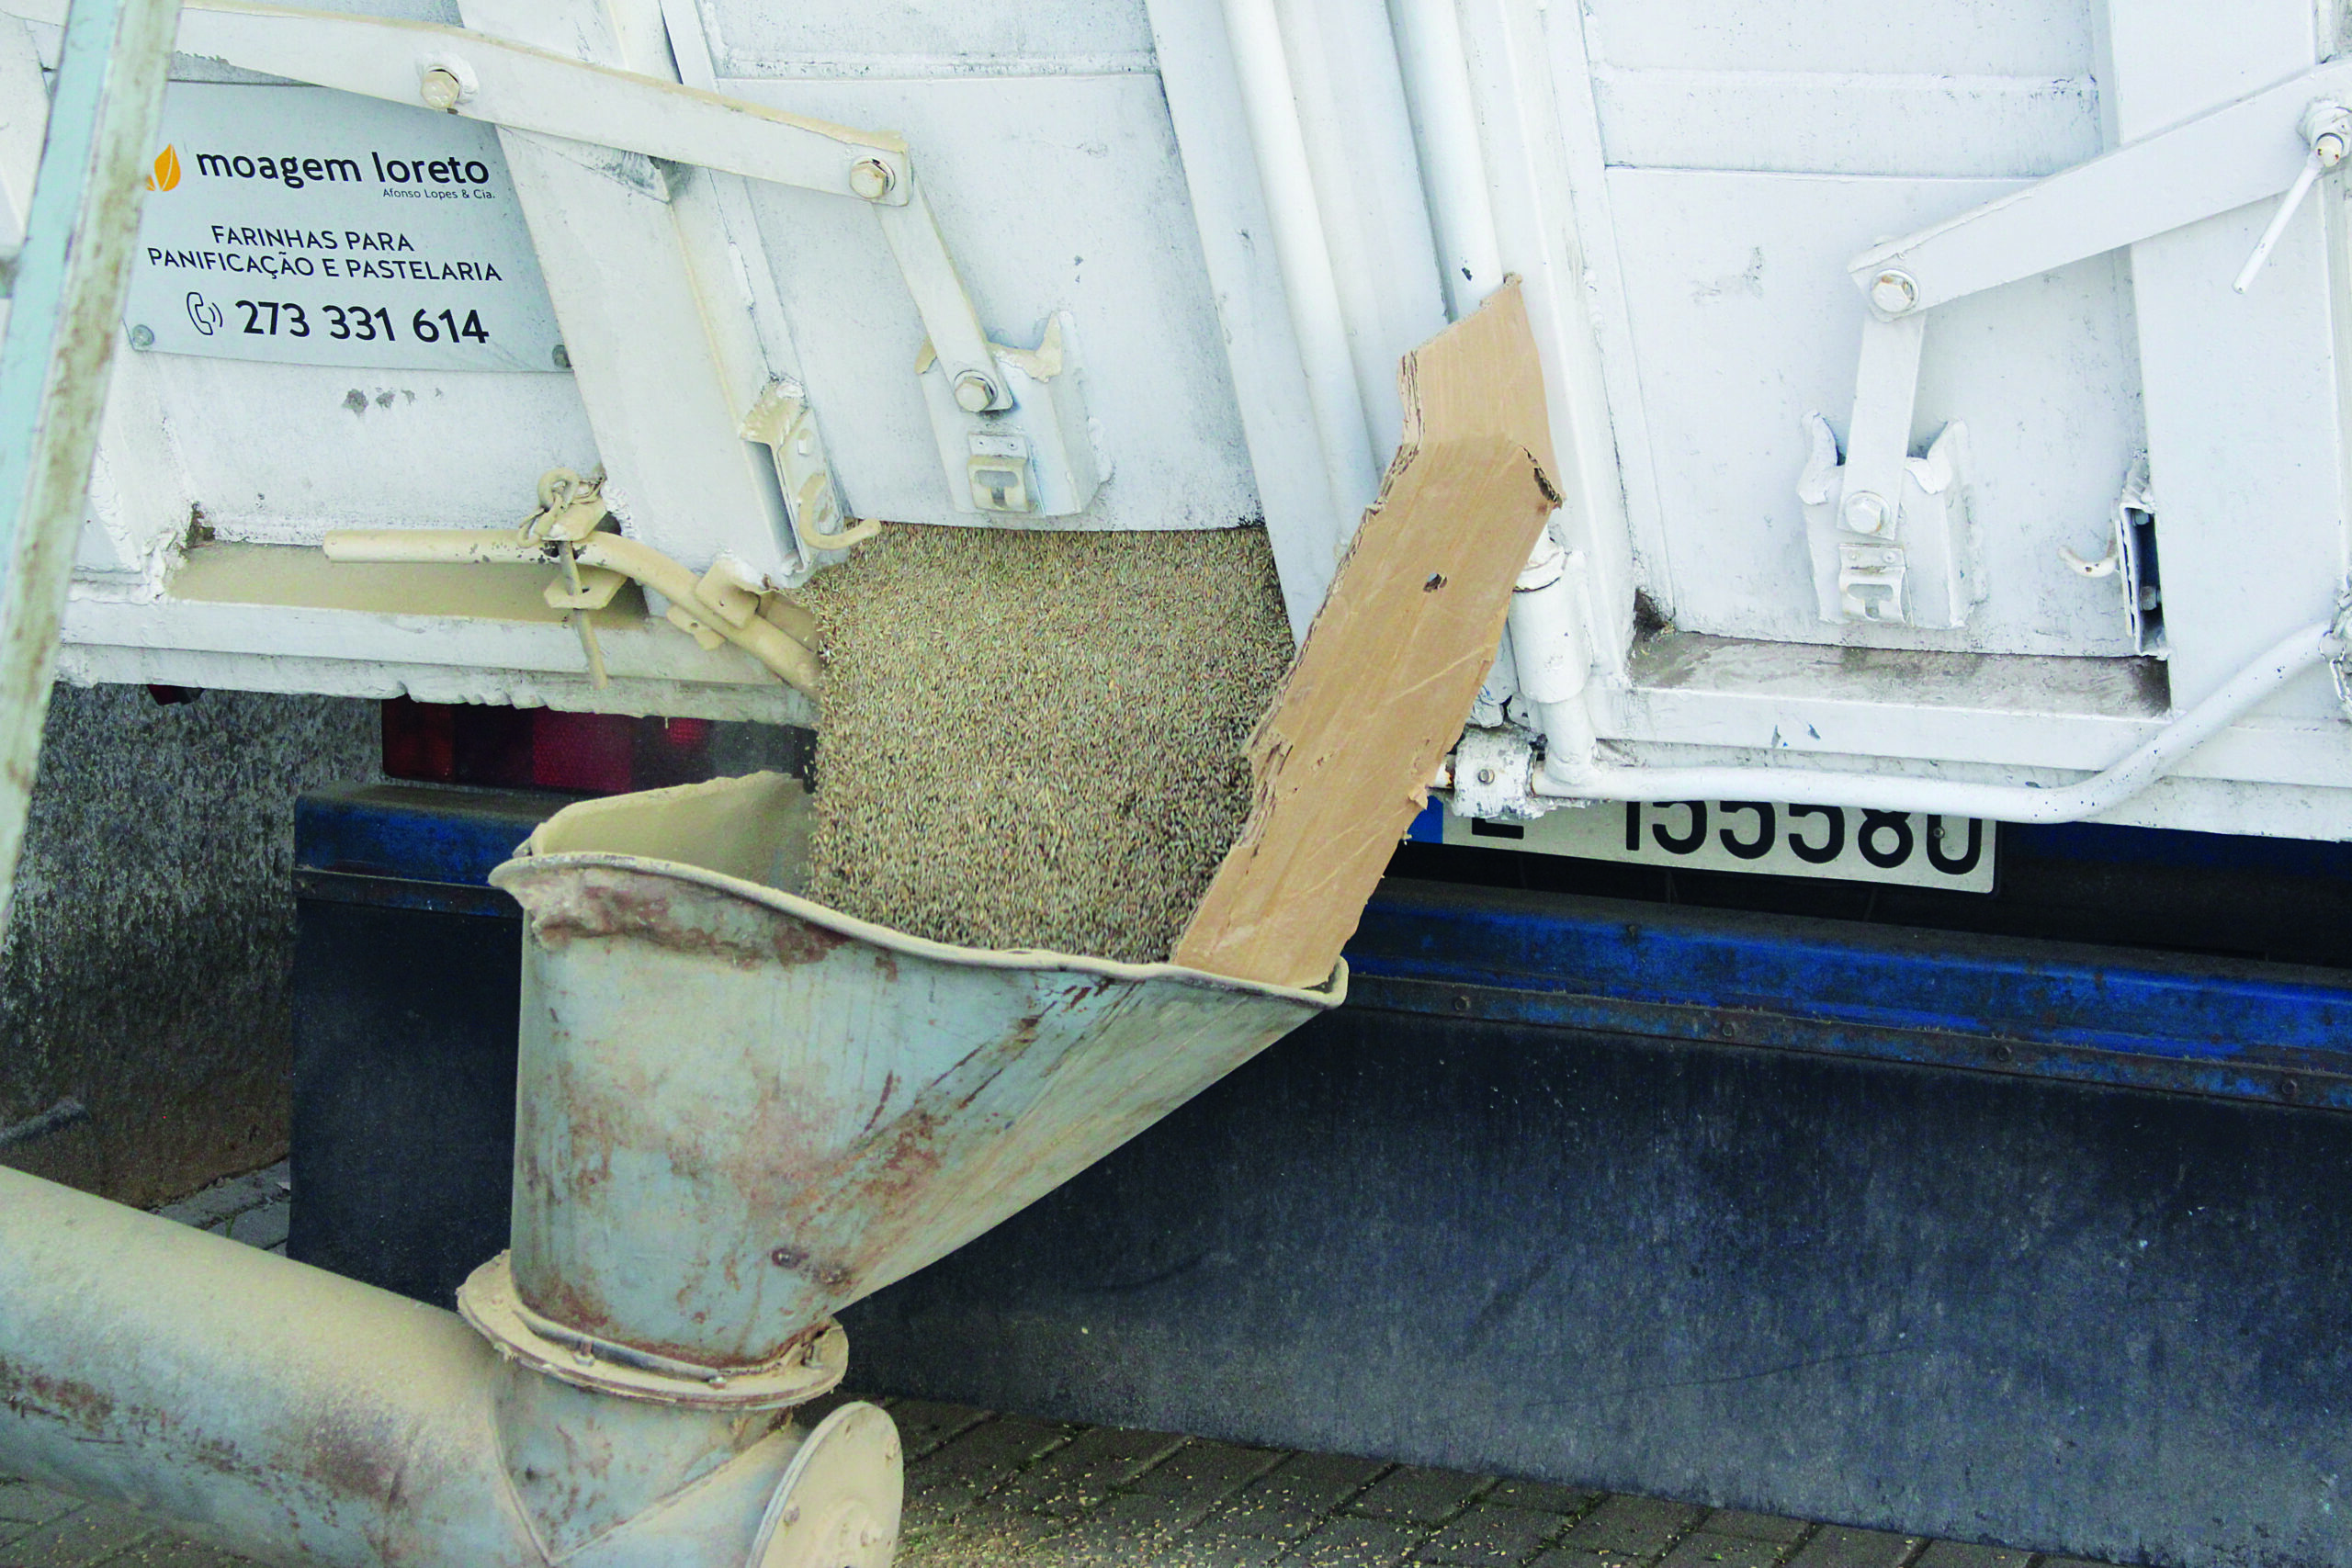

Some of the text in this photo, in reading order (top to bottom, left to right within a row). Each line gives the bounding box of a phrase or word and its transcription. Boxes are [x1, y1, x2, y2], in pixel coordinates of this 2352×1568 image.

[197, 152, 490, 188] moagem loreto
[382, 188, 496, 199] Afonso Lopes & Cia.
[211, 225, 414, 252] FARINHAS PARA
[147, 247, 503, 281] PANIFICAÇÃO E PASTELARIA
[235, 300, 490, 344] 273 331 614
